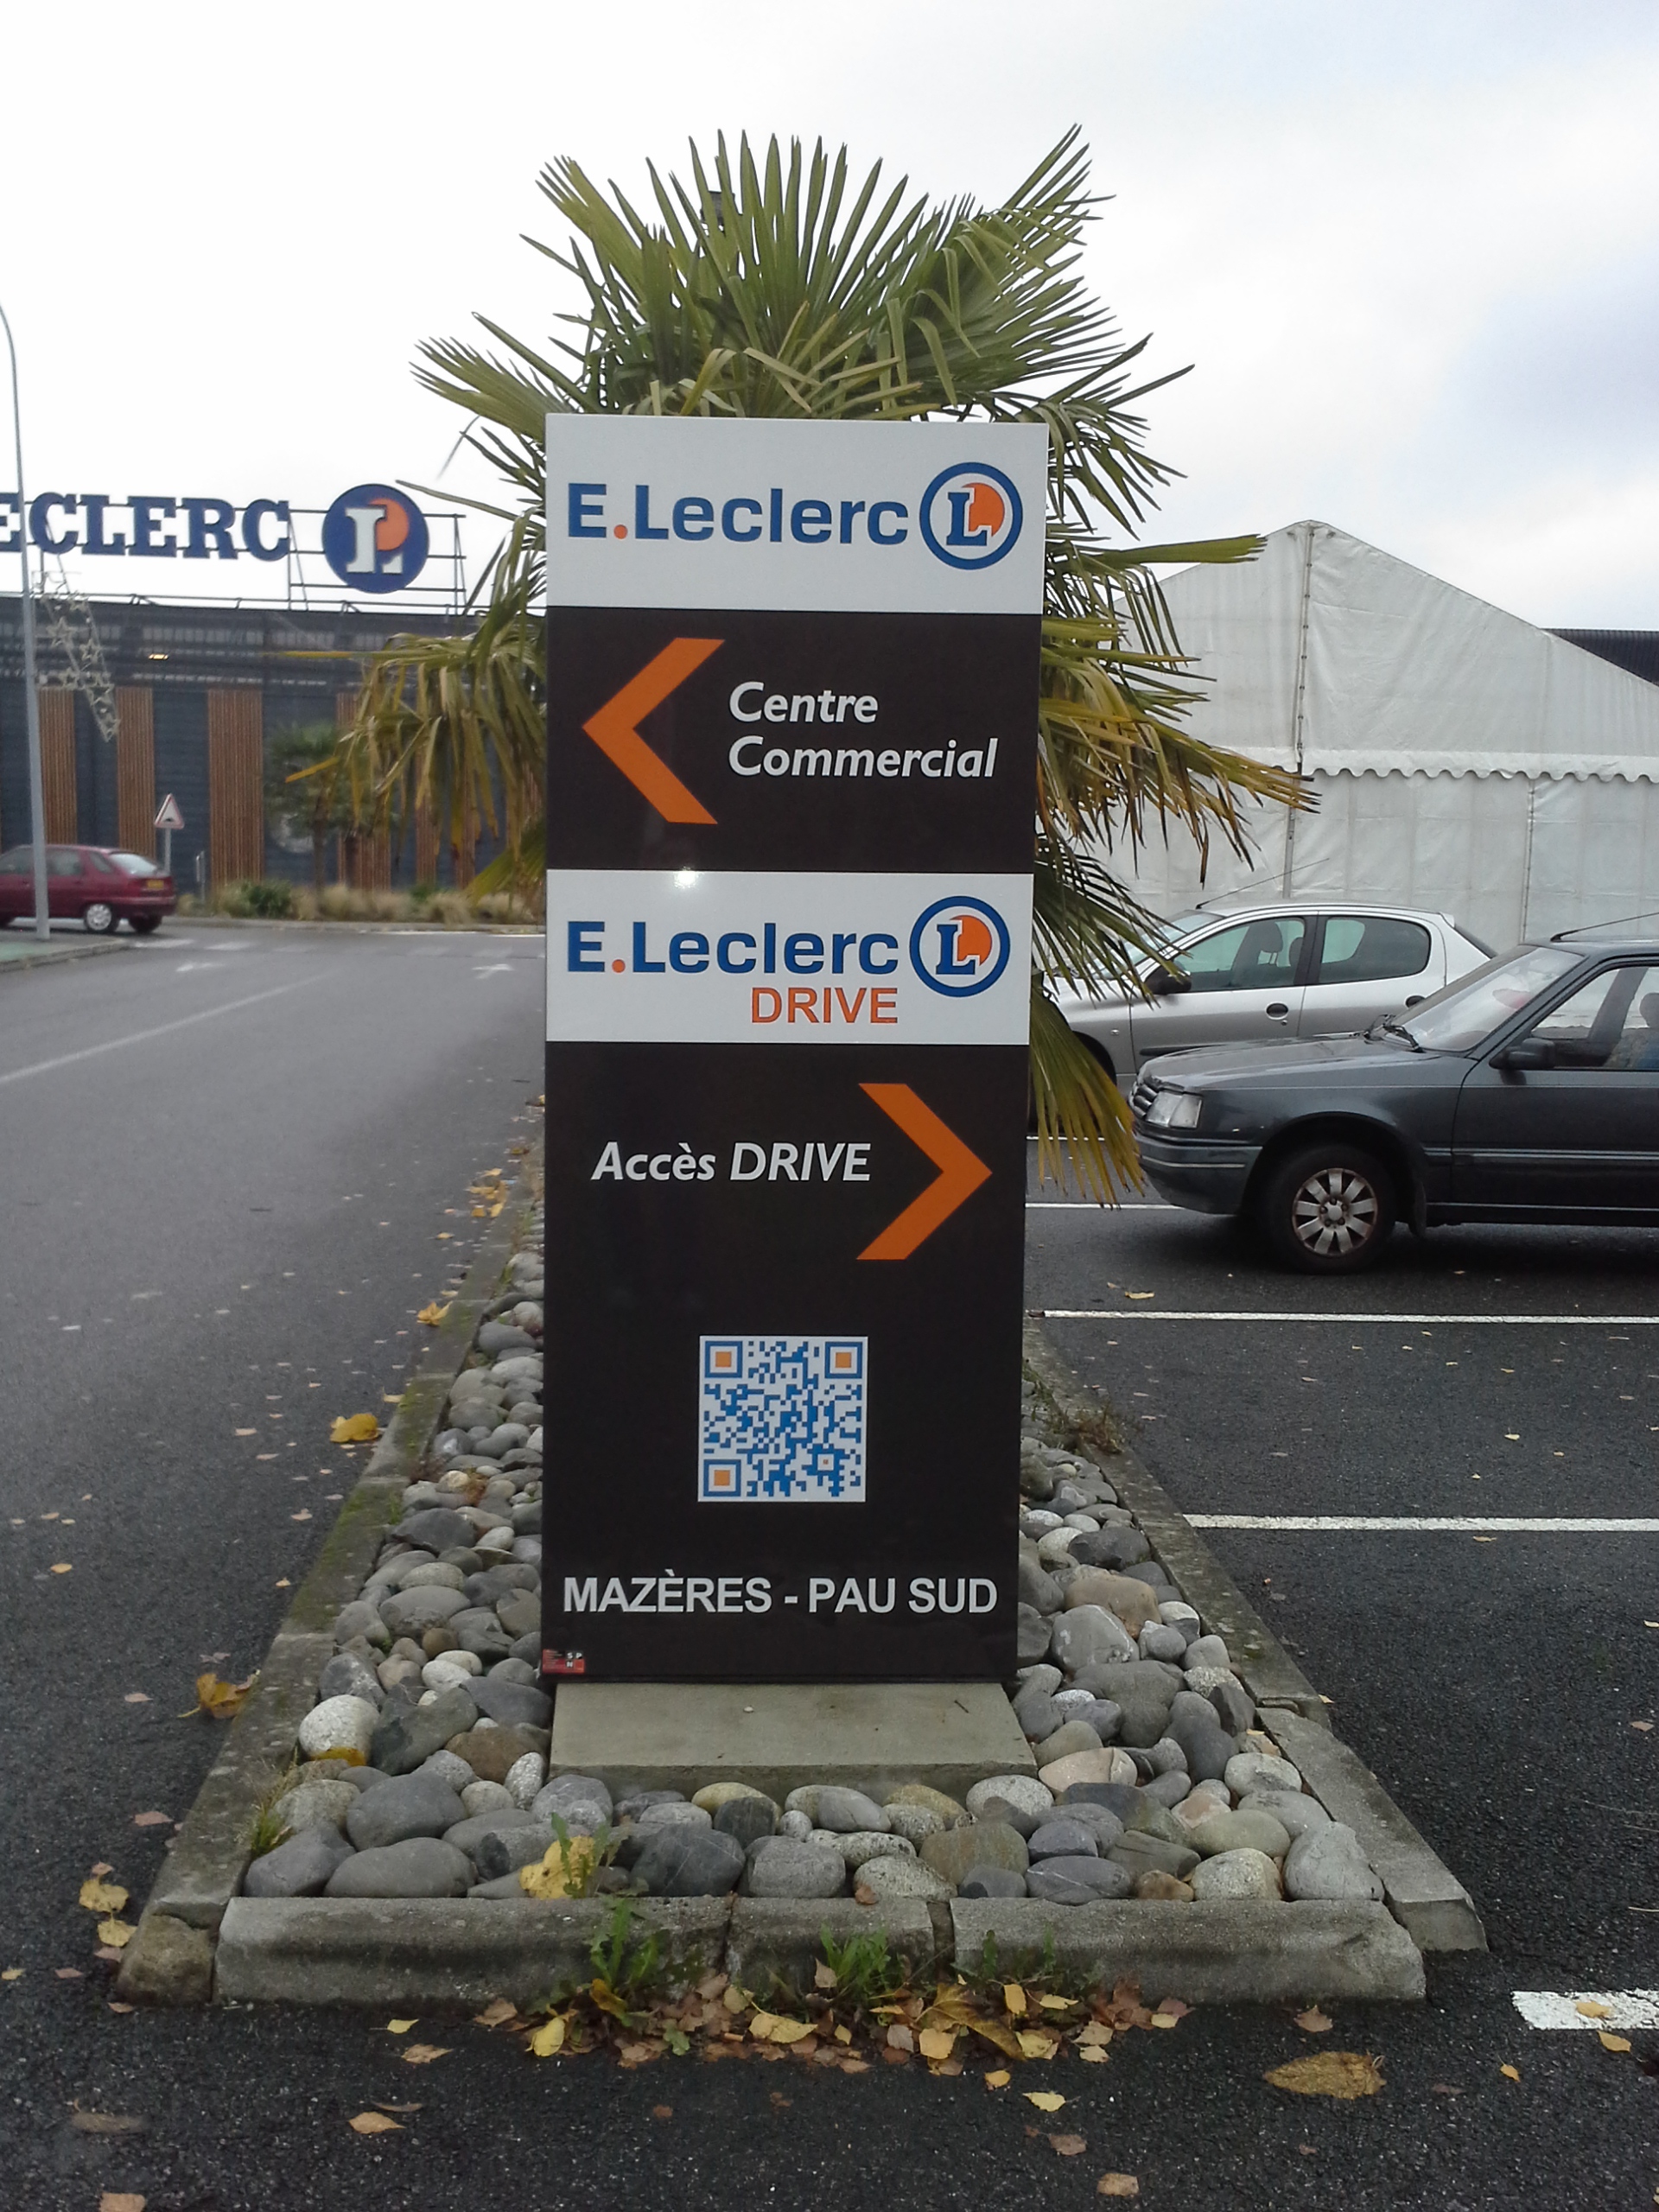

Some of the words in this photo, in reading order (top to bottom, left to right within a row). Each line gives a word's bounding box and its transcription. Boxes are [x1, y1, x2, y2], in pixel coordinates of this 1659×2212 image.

[567, 482, 909, 545] E.Leclerc
[728, 681, 879, 723] Centre
[728, 734, 999, 778] Commercial
[567, 920, 899, 975] E.Leclerc
[751, 987, 899, 1024] DRIVE
[590, 1141, 716, 1181] Accès
[729, 1142, 872, 1182] DRIVE
[563, 1568, 772, 1613] MAZÈRES
[808, 1578, 896, 1613] PAU
[907, 1577, 998, 1614] SUD
